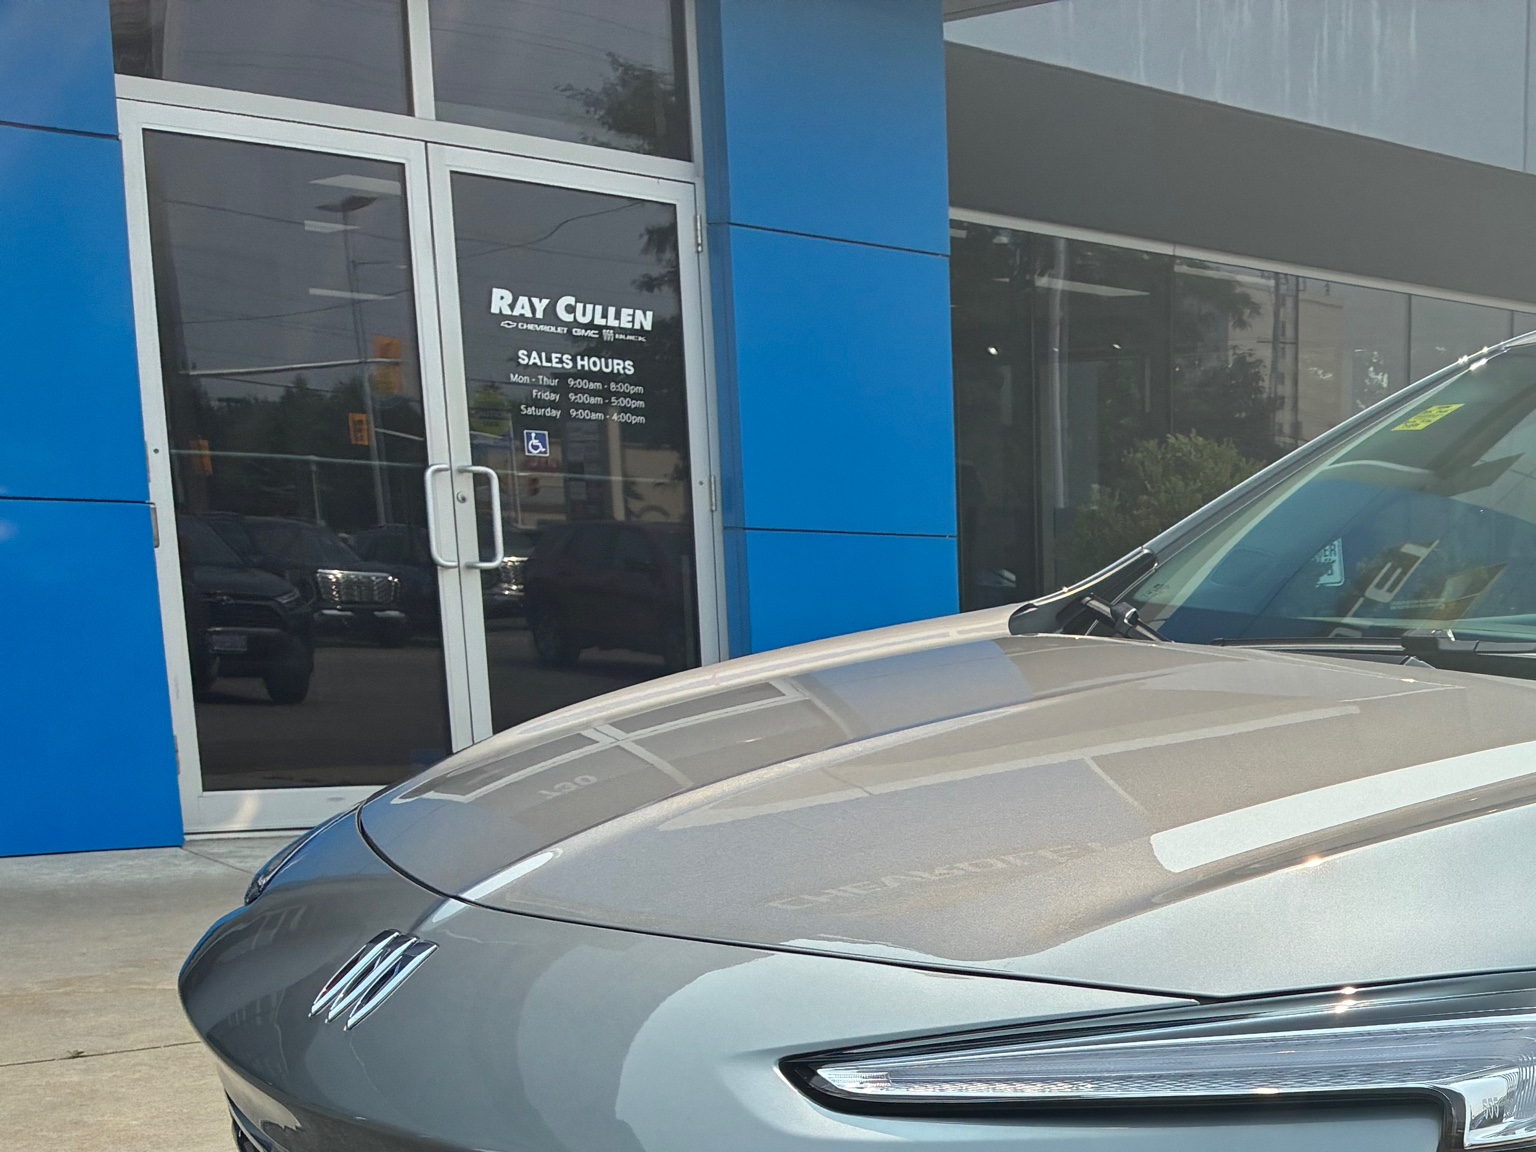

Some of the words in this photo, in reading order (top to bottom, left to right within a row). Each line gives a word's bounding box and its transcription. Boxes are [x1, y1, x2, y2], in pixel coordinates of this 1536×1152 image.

[490, 288, 551, 319] RAY
[556, 296, 654, 331] CULLEN
[518, 322, 568, 334] CHEVROLET
[572, 328, 600, 338] GMC
[518, 350, 573, 369] SALES
[577, 355, 634, 374] HOURS
[510, 373, 530, 384] Mon
[539, 375, 559, 386] Thur
[568, 378, 602, 390] 9:00am
[610, 382, 644, 394] 8:00pm
[532, 389, 560, 402] Friday
[568, 392, 603, 404] 9:00am
[611, 396, 645, 409] 5:00pm
[520, 404, 562, 418] Saturday
[570, 408, 604, 420] 9:00am
[612, 412, 646, 424] 4:00pm
